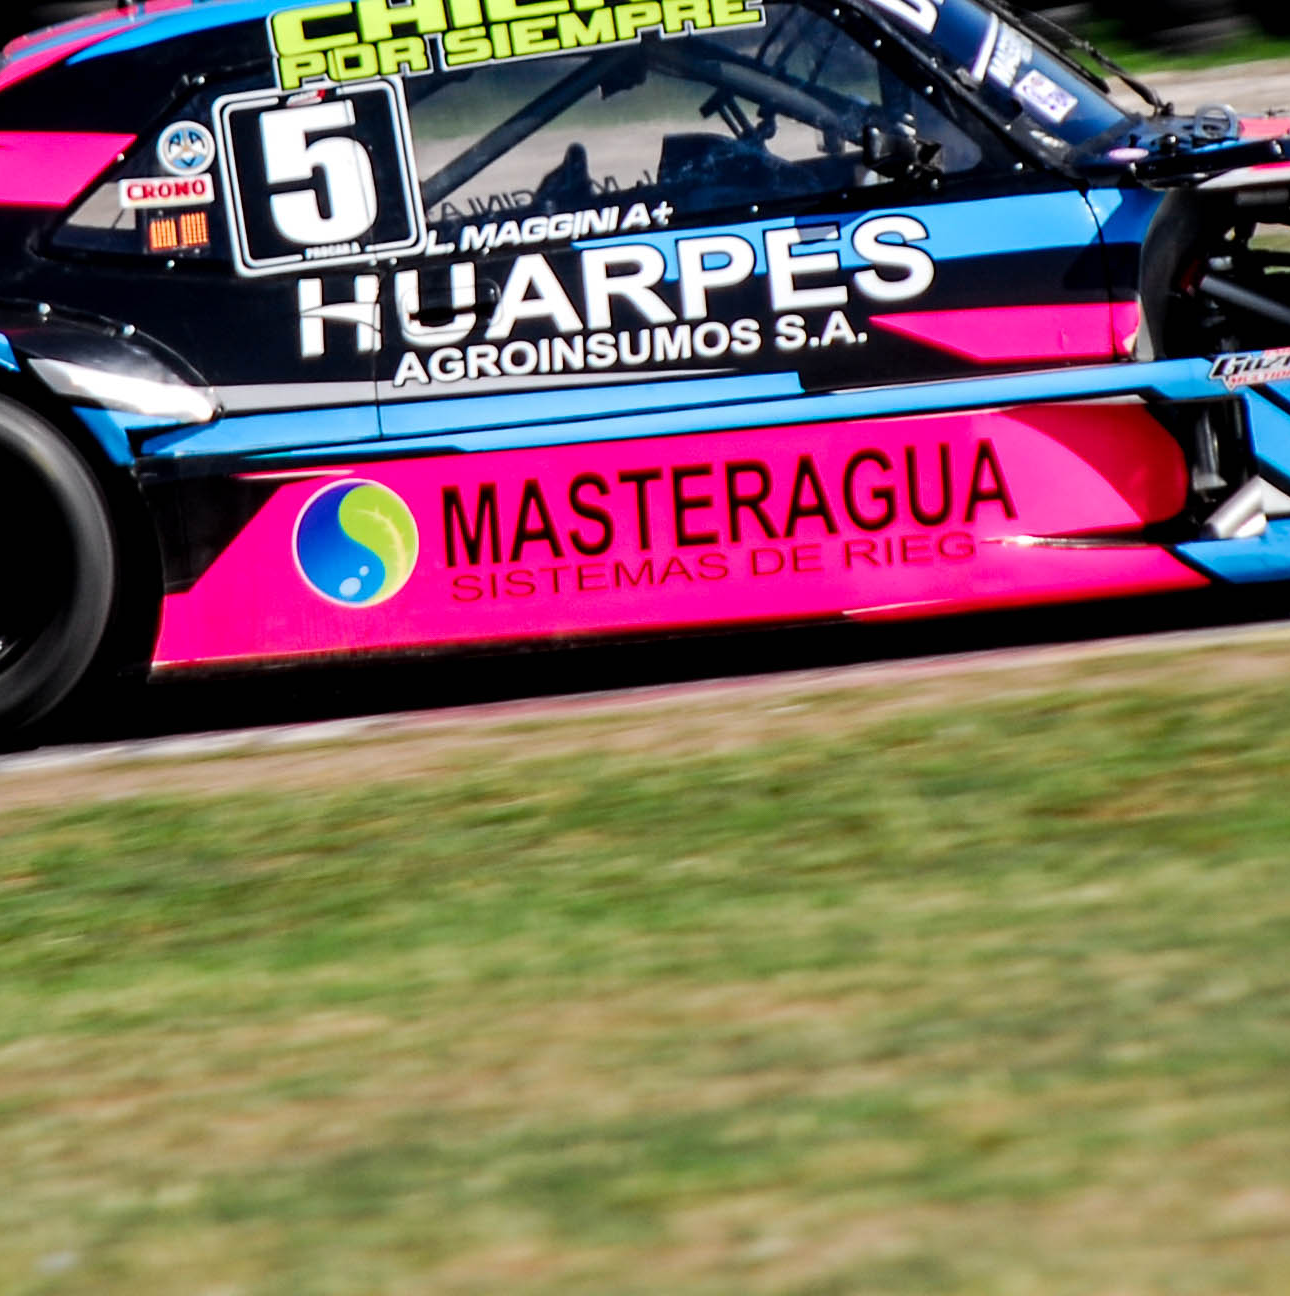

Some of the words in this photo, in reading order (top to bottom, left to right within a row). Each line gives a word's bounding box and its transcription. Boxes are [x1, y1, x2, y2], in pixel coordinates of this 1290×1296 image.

[280, 35, 430, 90] POR
[127, 179, 207, 201] CRONO
[259, 98, 379, 246] 5
[424, 229, 455, 255] L.
[459, 206, 621, 253] MAGGINI
[296, 214, 936, 358] HUARPES
[392, 317, 762, 389] AGROINSUMOS
[773, 310, 869, 350] S.A.
[440, 437, 1020, 569] MASTERAGUA
[450, 551, 730, 602] SISTEMAS
[750, 541, 824, 578] DE
